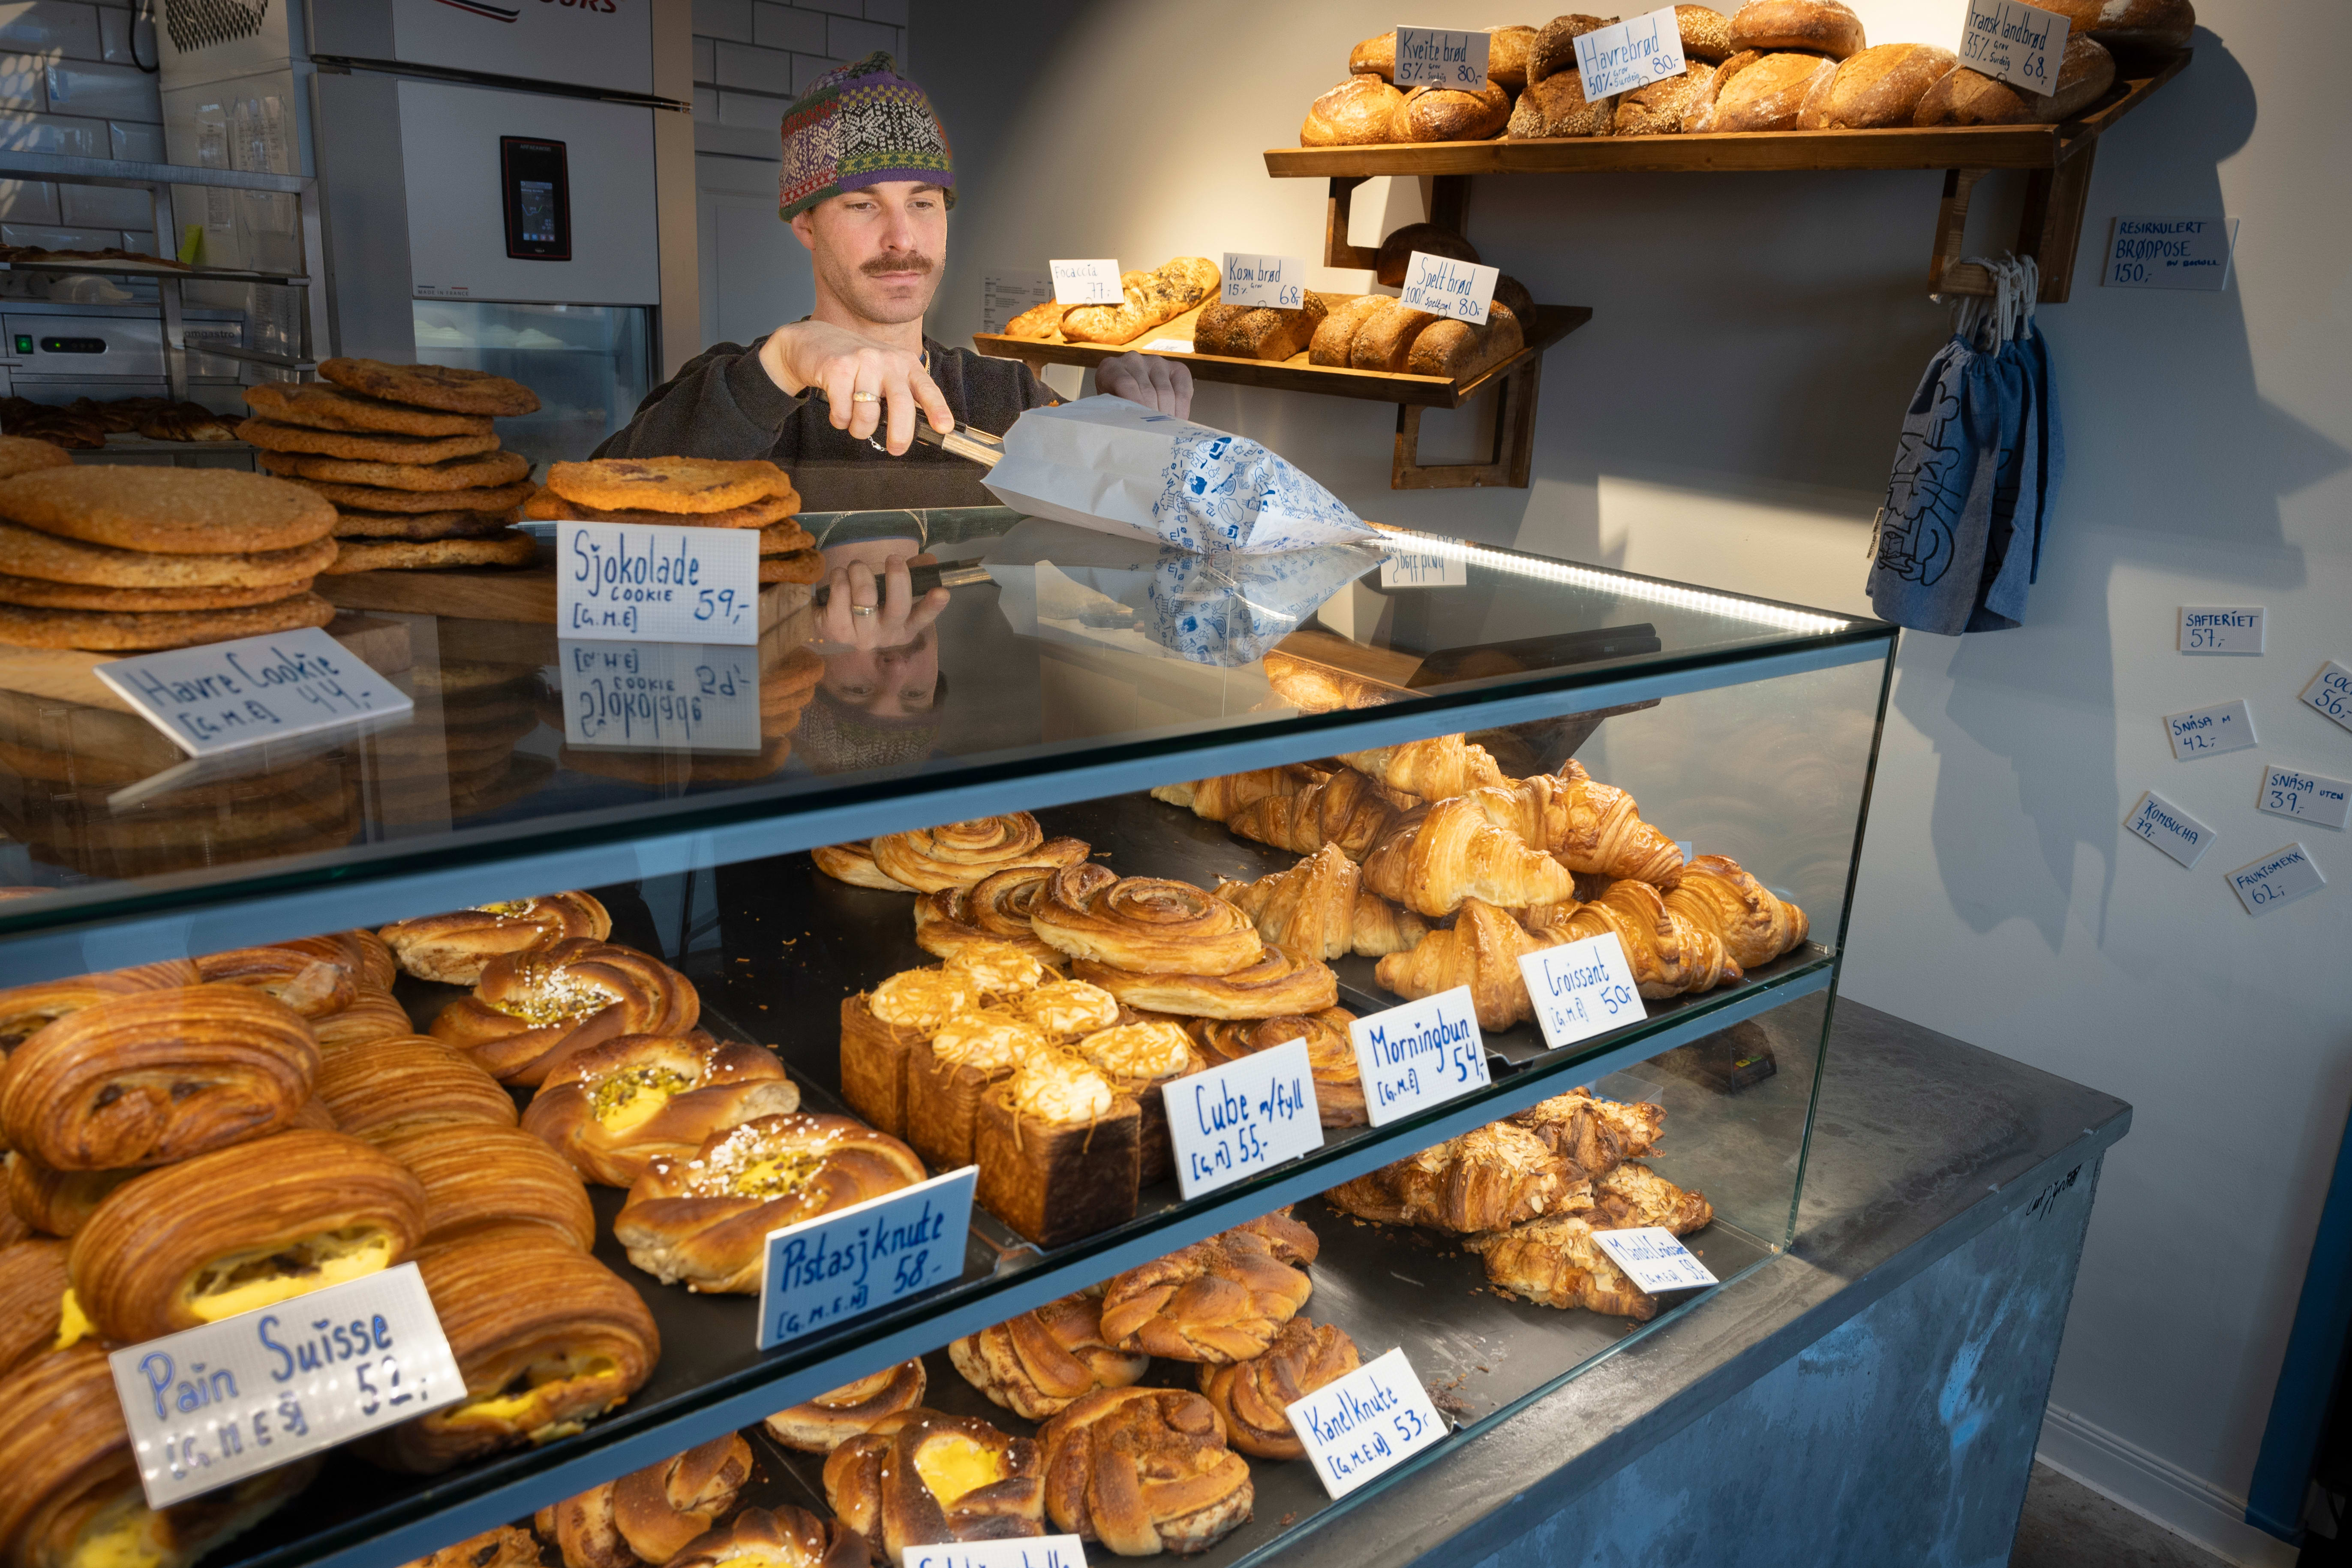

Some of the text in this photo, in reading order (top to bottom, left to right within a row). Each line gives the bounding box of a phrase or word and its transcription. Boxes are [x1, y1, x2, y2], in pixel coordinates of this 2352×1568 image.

[1403, 31, 1468, 63] Kveite brød
[1581, 17, 1659, 75] Havrebrød
[1994, 40, 2009, 51] Grov
[2001, 6, 2050, 51] landbrød
[1401, 63, 1423, 81] 5%
[1989, 52, 2010, 71] Surdeig
[1589, 66, 1628, 95] 50% Grov
[2120, 221, 2207, 235] RESIRKULERT
[2116, 238, 2191, 262] BRØDPOSE
[1055, 264, 1097, 278] Focaccia
[1258, 258, 1281, 282] brød
[1417, 257, 1475, 296] Spelt brød
[574, 529, 700, 597] Sjokolade
[611, 586, 673, 602] COOKIE
[126, 646, 339, 707] Havre Cookie
[2320, 790, 2343, 800] UTEN
[2144, 800, 2198, 845] KOMBUCHA
[2236, 852, 2305, 889] FRUKTSMEKK
[1544, 946, 1609, 996] Croissant
[1370, 1008, 1470, 1073] Morningbun
[1196, 1078, 1249, 1136] Cube
[781, 1199, 944, 1293] Pistasjknute
[138, 1314, 394, 1421] Pain Suisse
